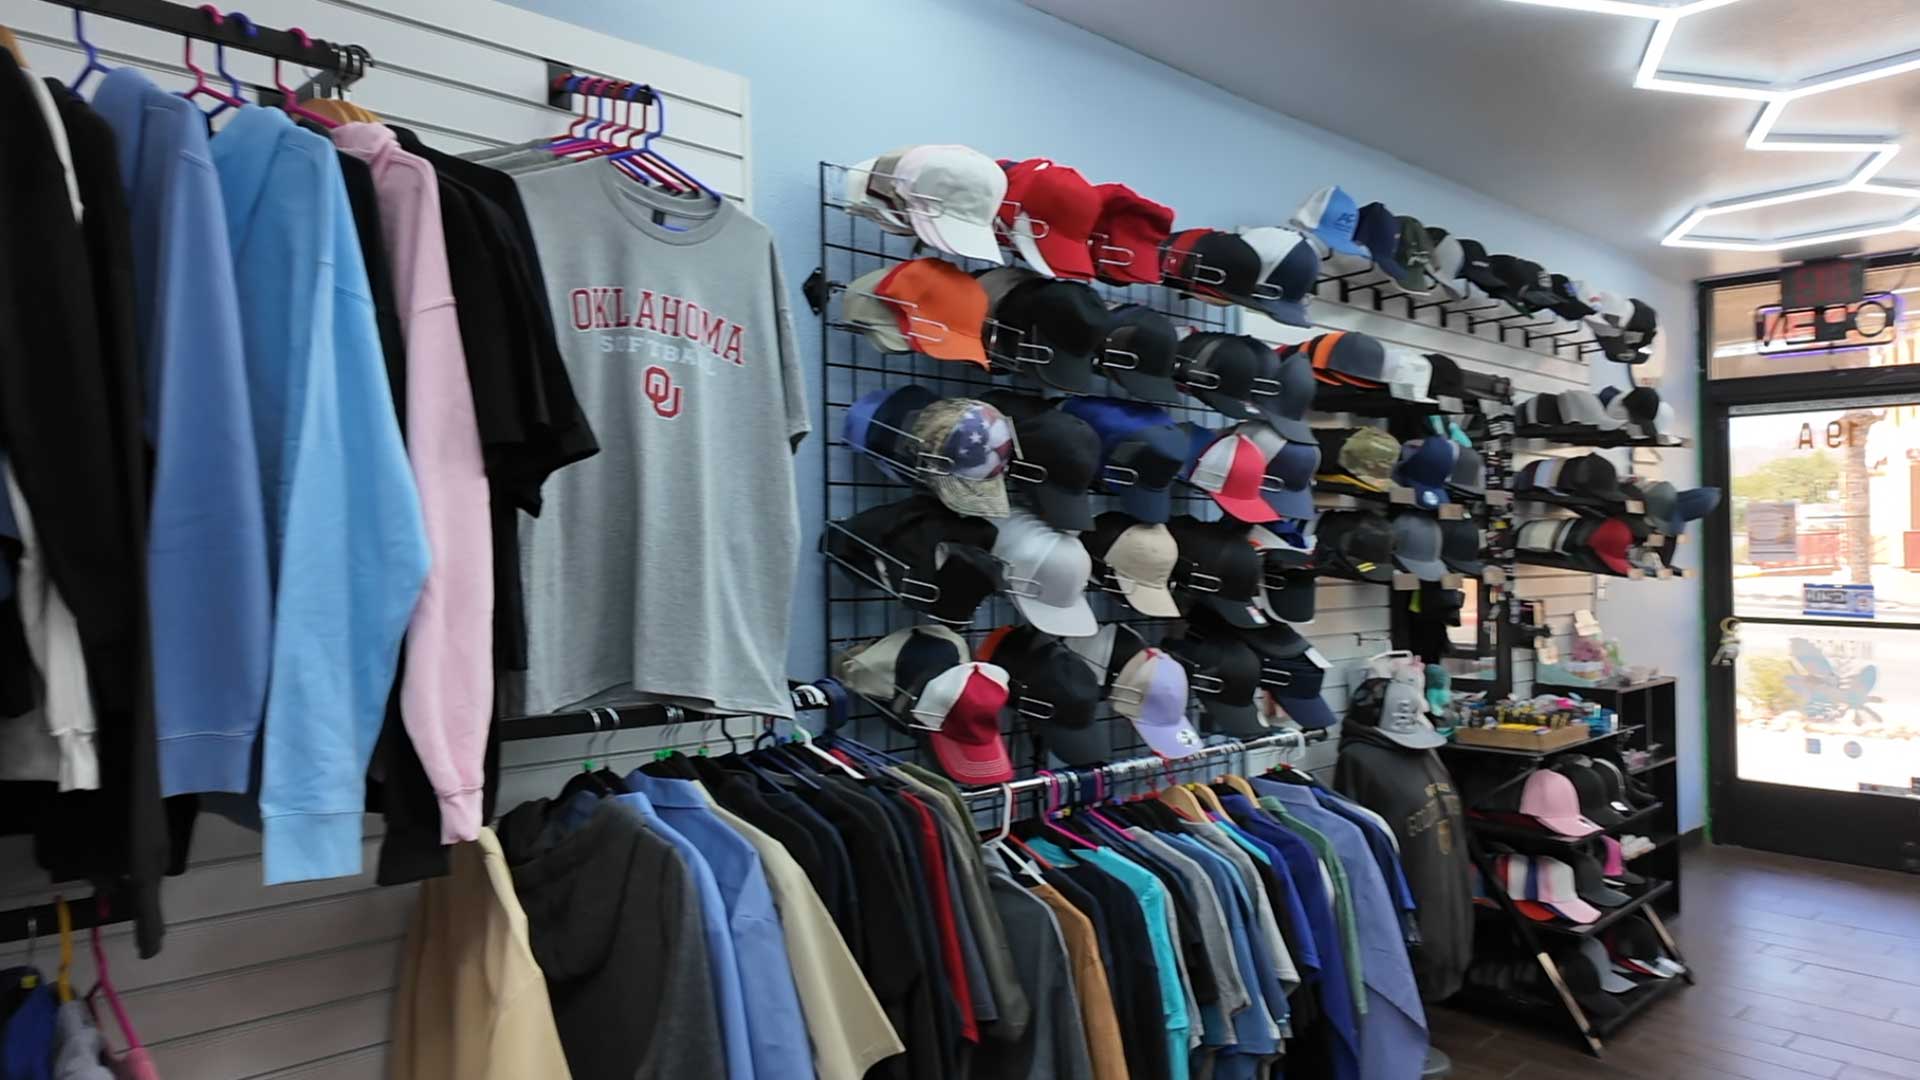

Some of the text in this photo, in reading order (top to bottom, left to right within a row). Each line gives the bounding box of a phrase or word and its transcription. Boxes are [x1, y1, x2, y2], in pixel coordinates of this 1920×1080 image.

[570, 286, 747, 366] OKLAHOMA
[599, 334, 717, 376] SOFTBAL
[643, 365, 684, 421] OU
